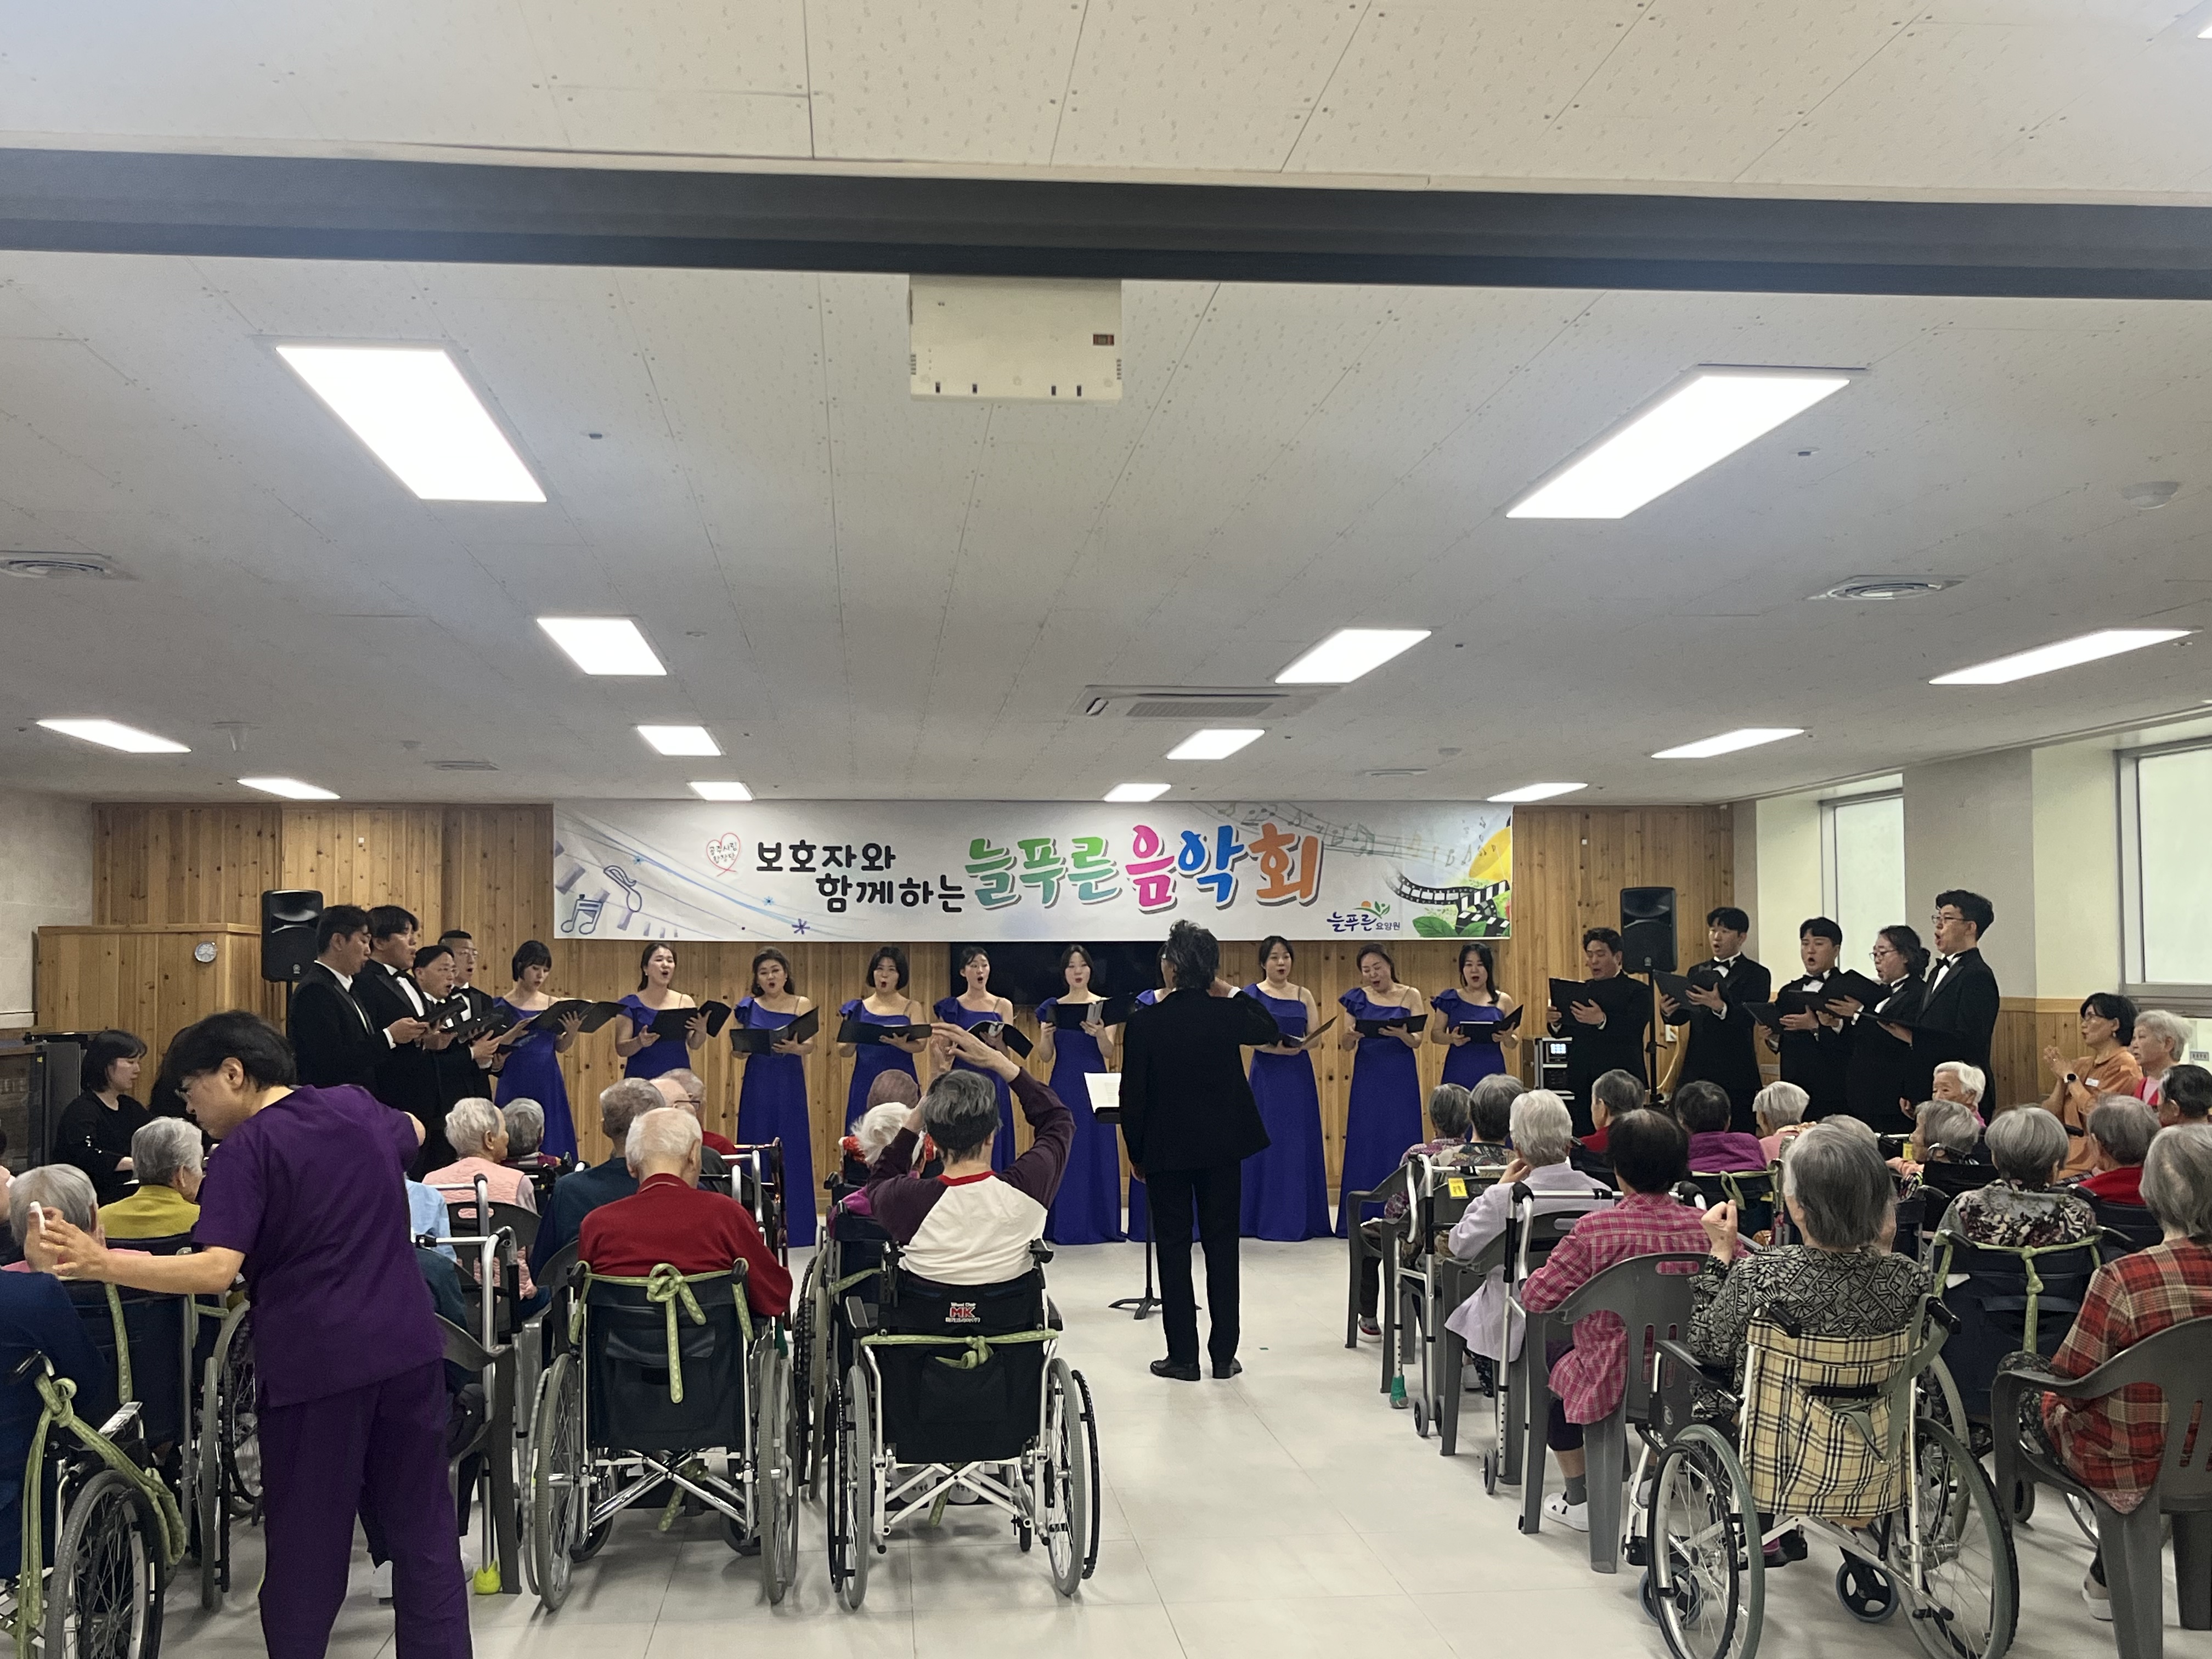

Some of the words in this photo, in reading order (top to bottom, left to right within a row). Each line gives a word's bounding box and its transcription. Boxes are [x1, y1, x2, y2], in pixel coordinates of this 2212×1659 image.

[756, 839, 896, 872] 보호자와
[815, 873, 966, 913] 함께하는
[1327, 911, 1377, 932] 늘푸른
[1375, 922, 1401, 930] 요양원
[950, 1306, 976, 1318] MK
